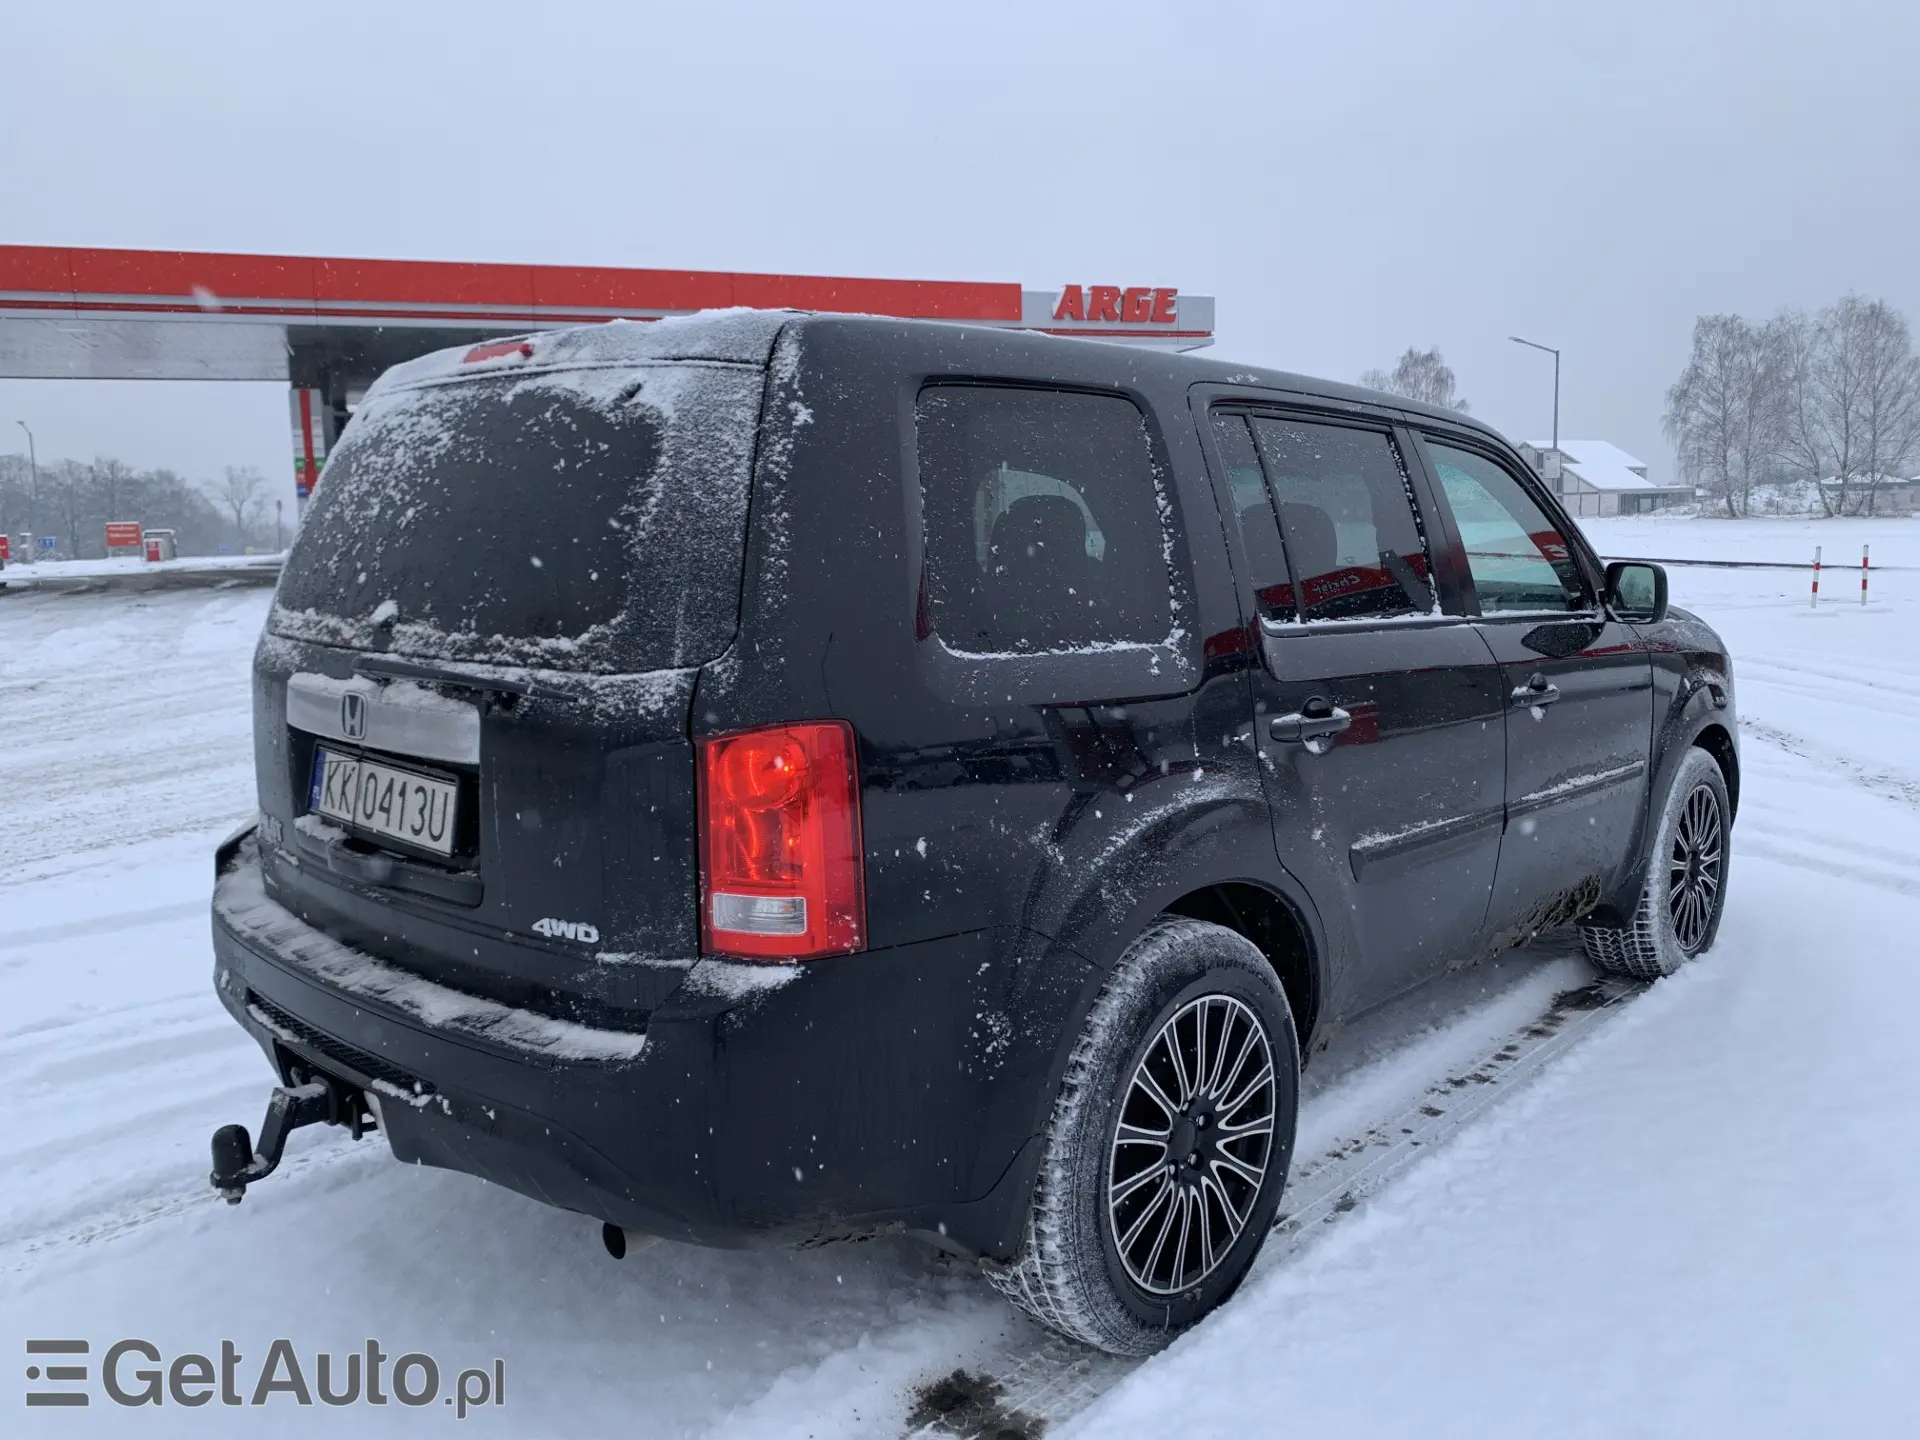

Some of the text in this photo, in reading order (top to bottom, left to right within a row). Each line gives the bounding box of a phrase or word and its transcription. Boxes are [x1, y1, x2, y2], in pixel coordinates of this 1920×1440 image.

[1052, 284, 1178, 323] ARGE
[324, 761, 449, 842] KK 0413U
[532, 917, 599, 944] 4WD
